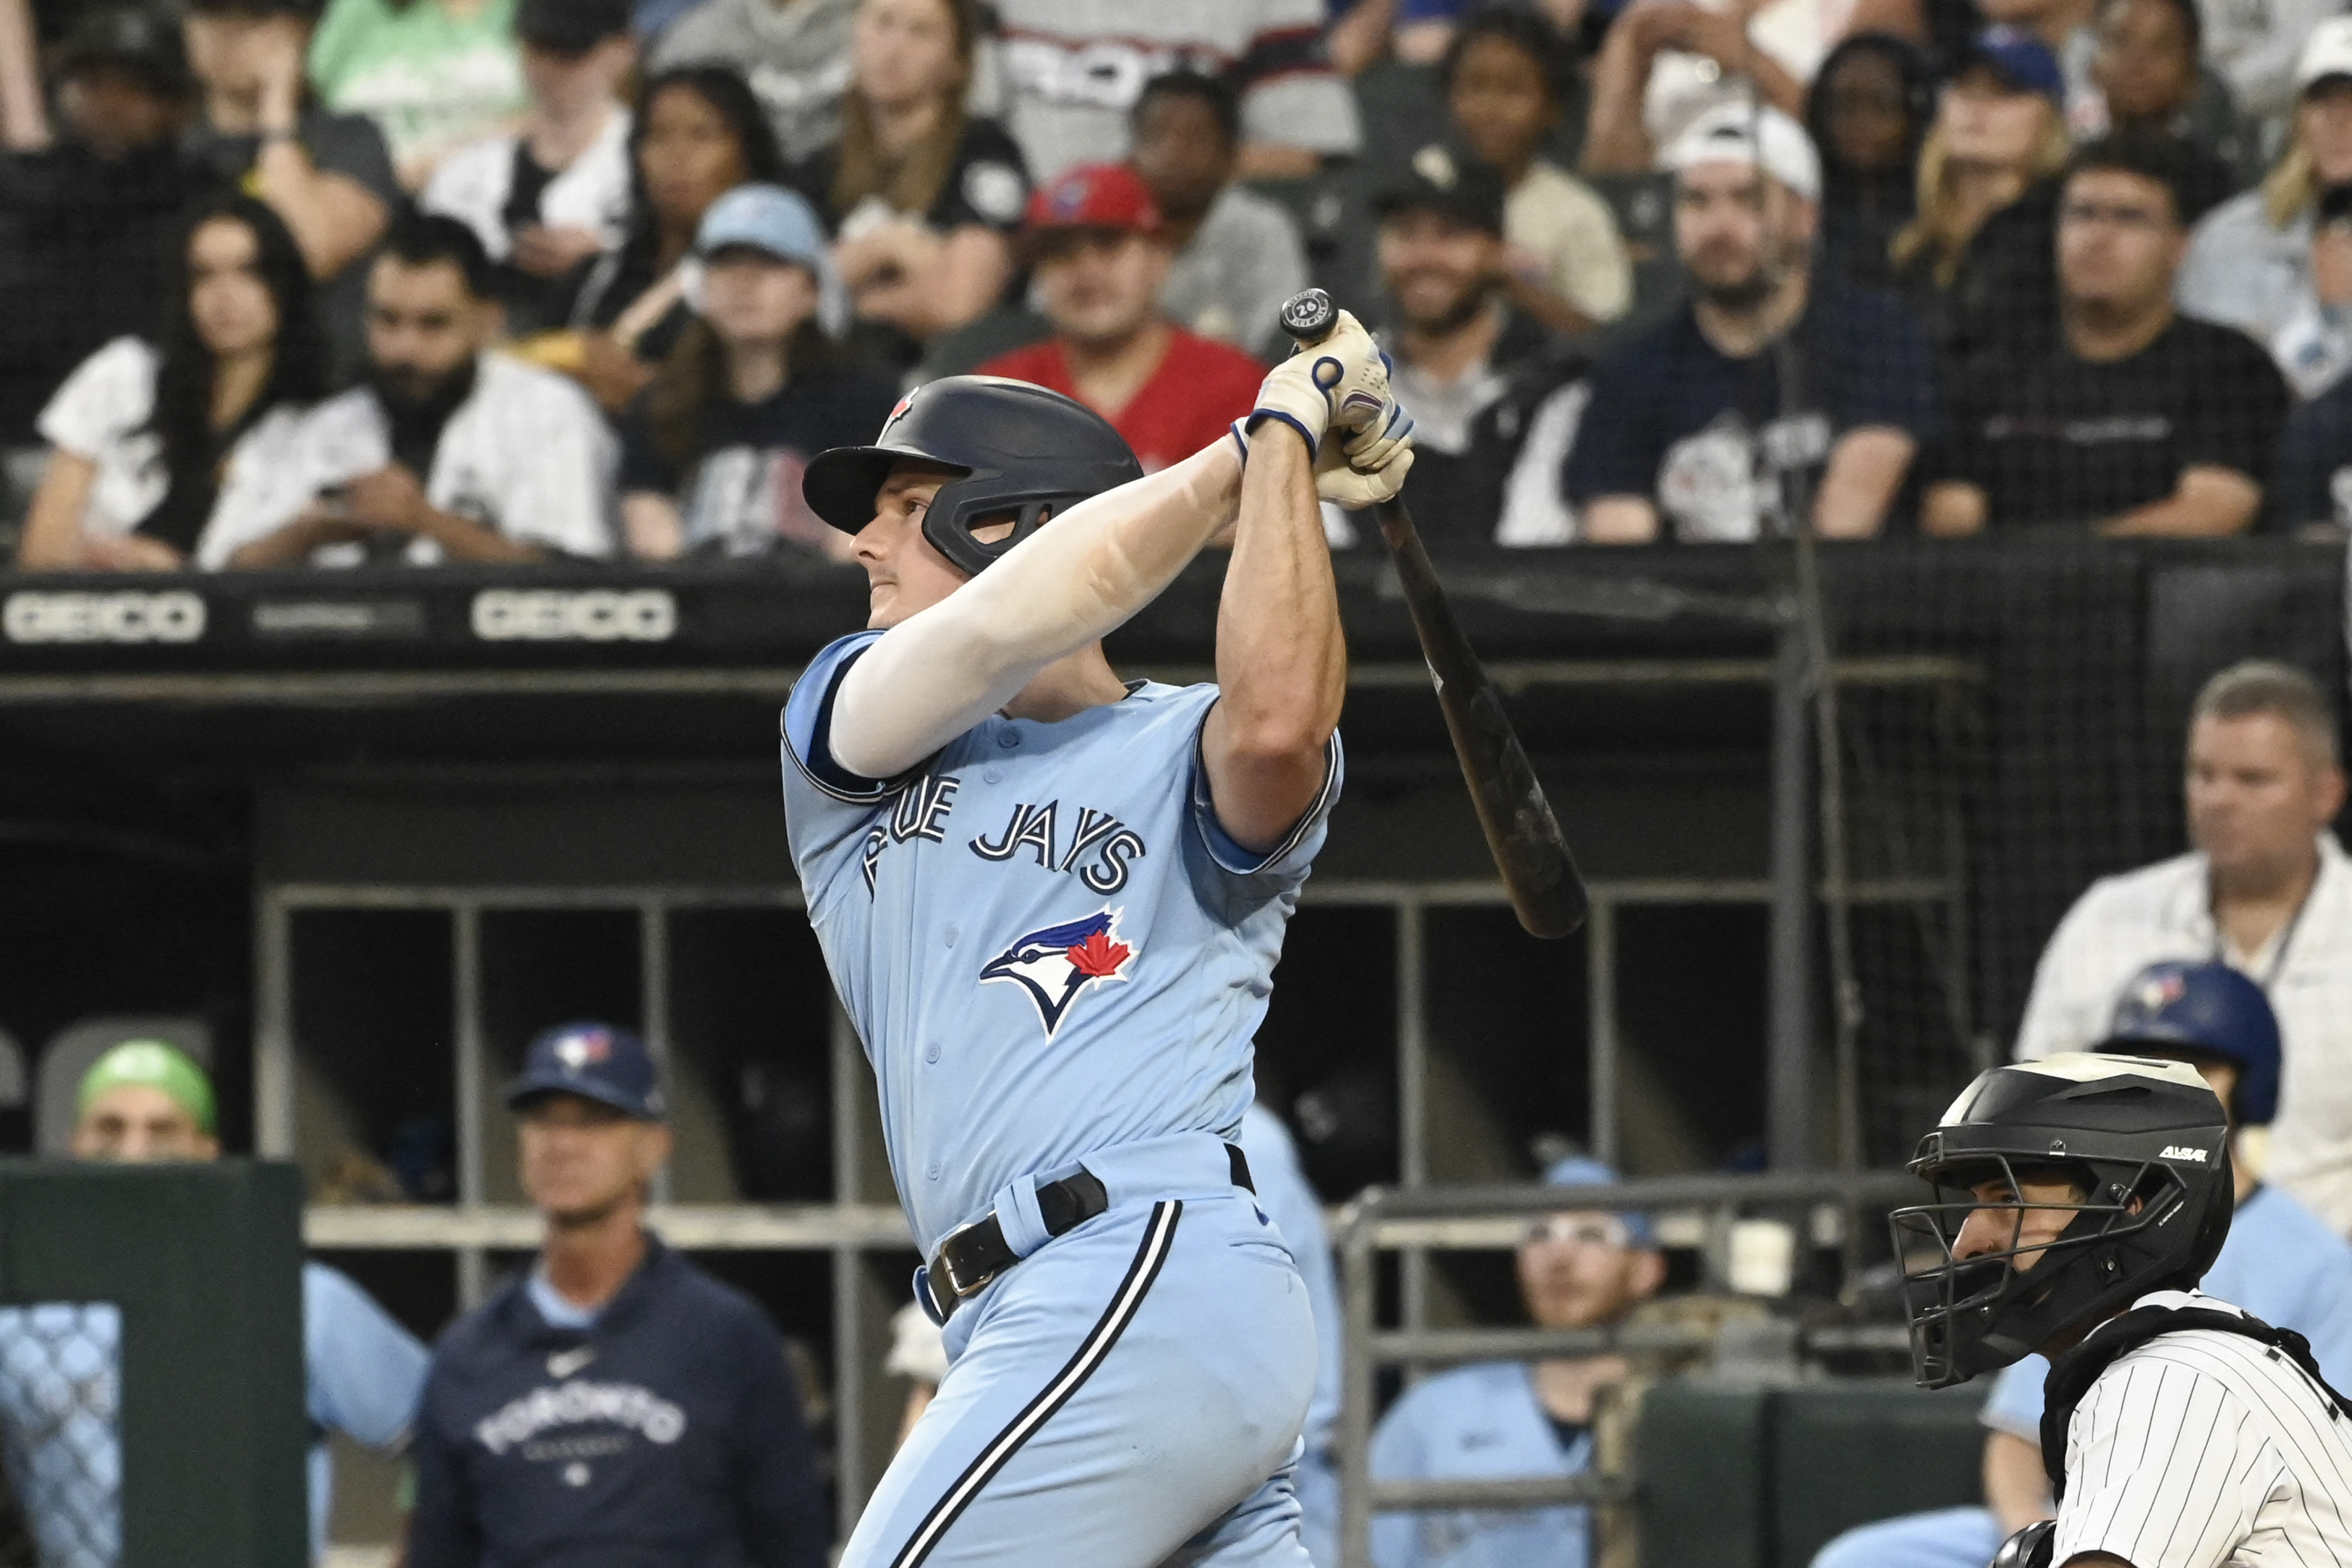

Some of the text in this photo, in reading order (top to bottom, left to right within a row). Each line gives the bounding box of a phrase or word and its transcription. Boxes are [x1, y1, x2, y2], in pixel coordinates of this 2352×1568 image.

[1295, 301, 1316, 317] 26
[2, 589, 205, 643] GEICO
[471, 587, 678, 642] GEICO
[861, 775, 1146, 903] UE JAYS
